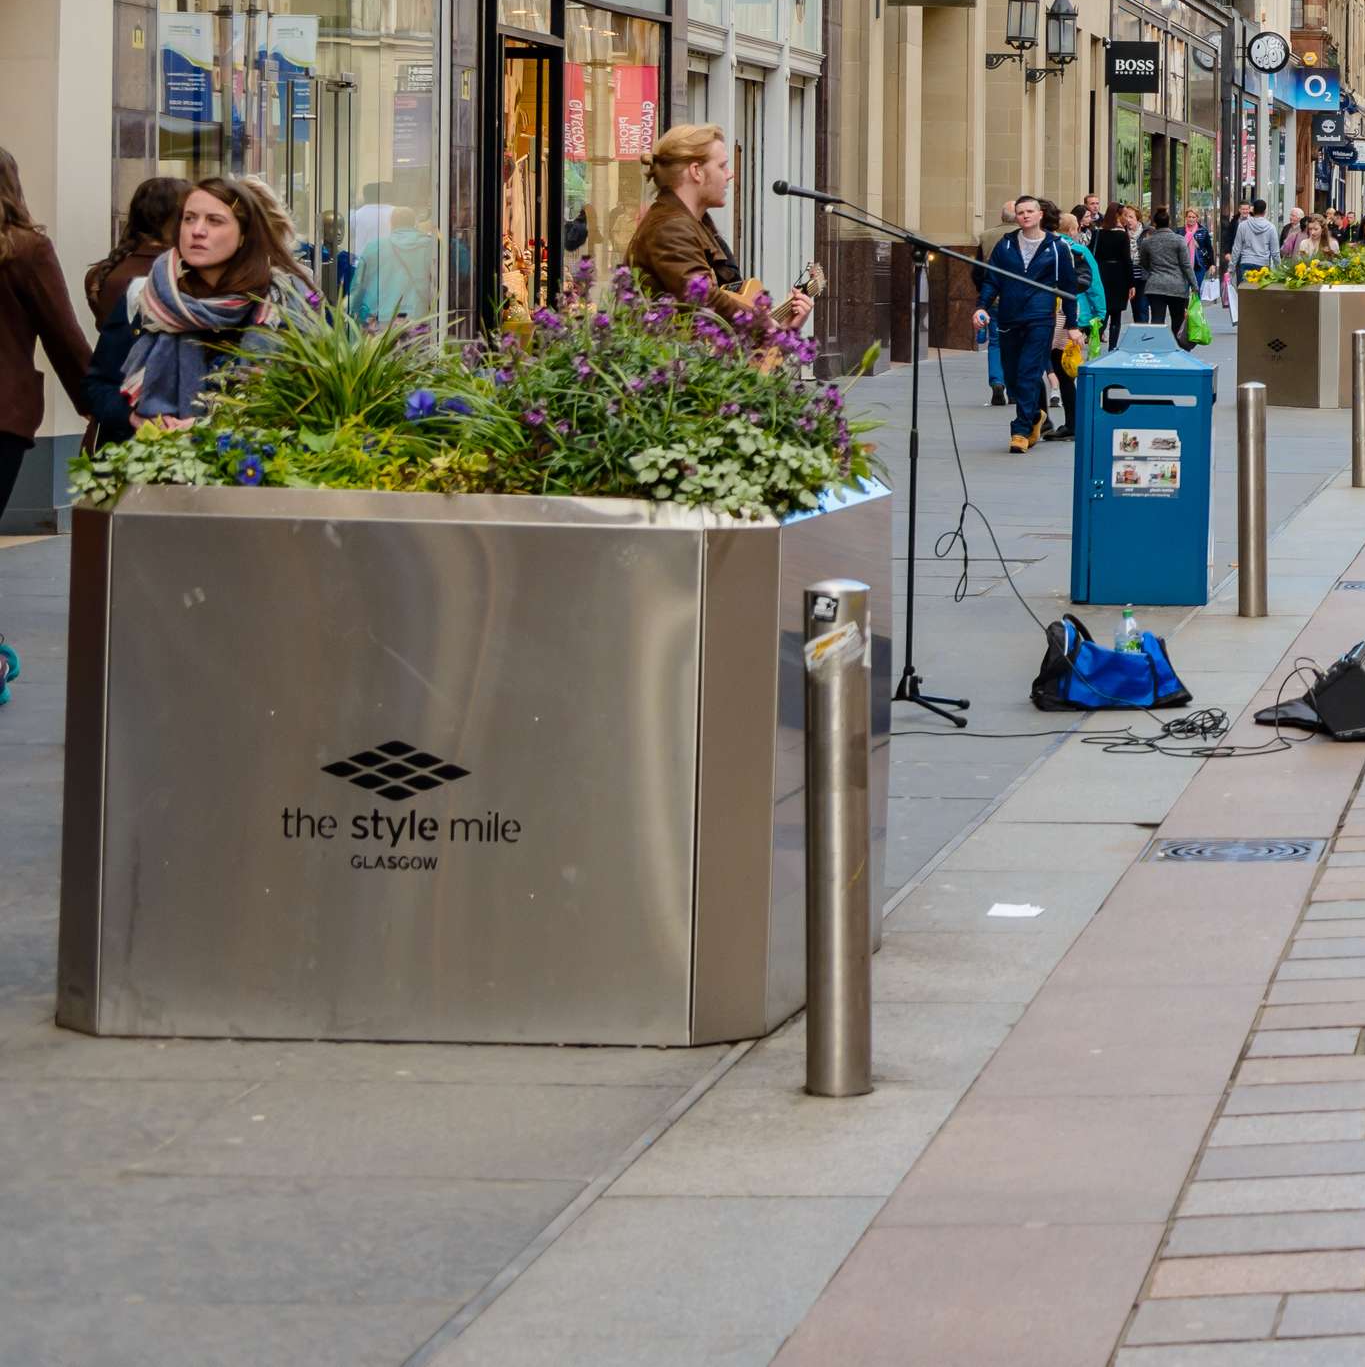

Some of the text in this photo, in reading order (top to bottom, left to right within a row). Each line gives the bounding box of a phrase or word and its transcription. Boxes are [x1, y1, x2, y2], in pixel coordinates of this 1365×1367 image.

[1115, 59, 1155, 71] BOSS
[281, 806, 523, 848] the style mile
[350, 855, 439, 872] GLASGOW
